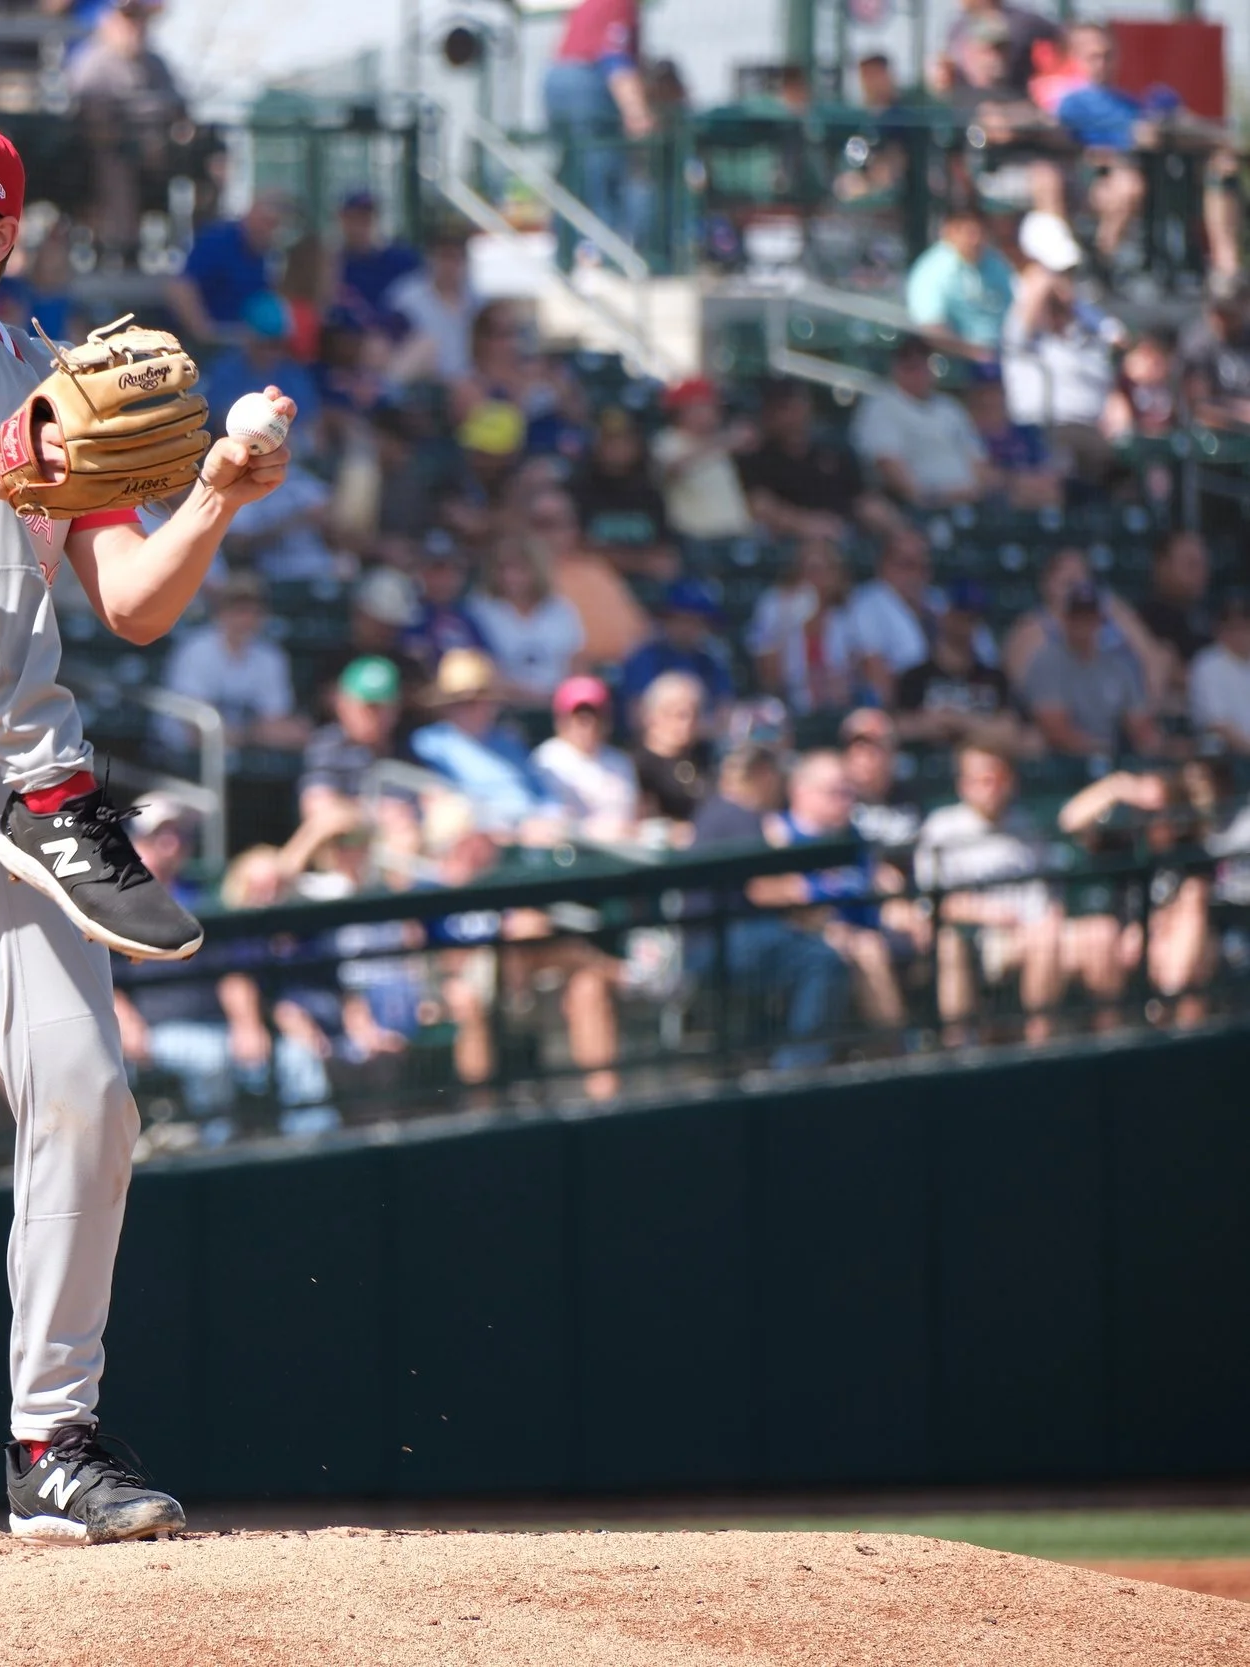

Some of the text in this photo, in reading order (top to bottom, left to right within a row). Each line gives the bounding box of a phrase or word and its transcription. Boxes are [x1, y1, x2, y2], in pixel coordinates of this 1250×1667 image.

[118, 364, 172, 390] Rawlings
[40, 837, 91, 878] N
[37, 1467, 81, 1510] N
